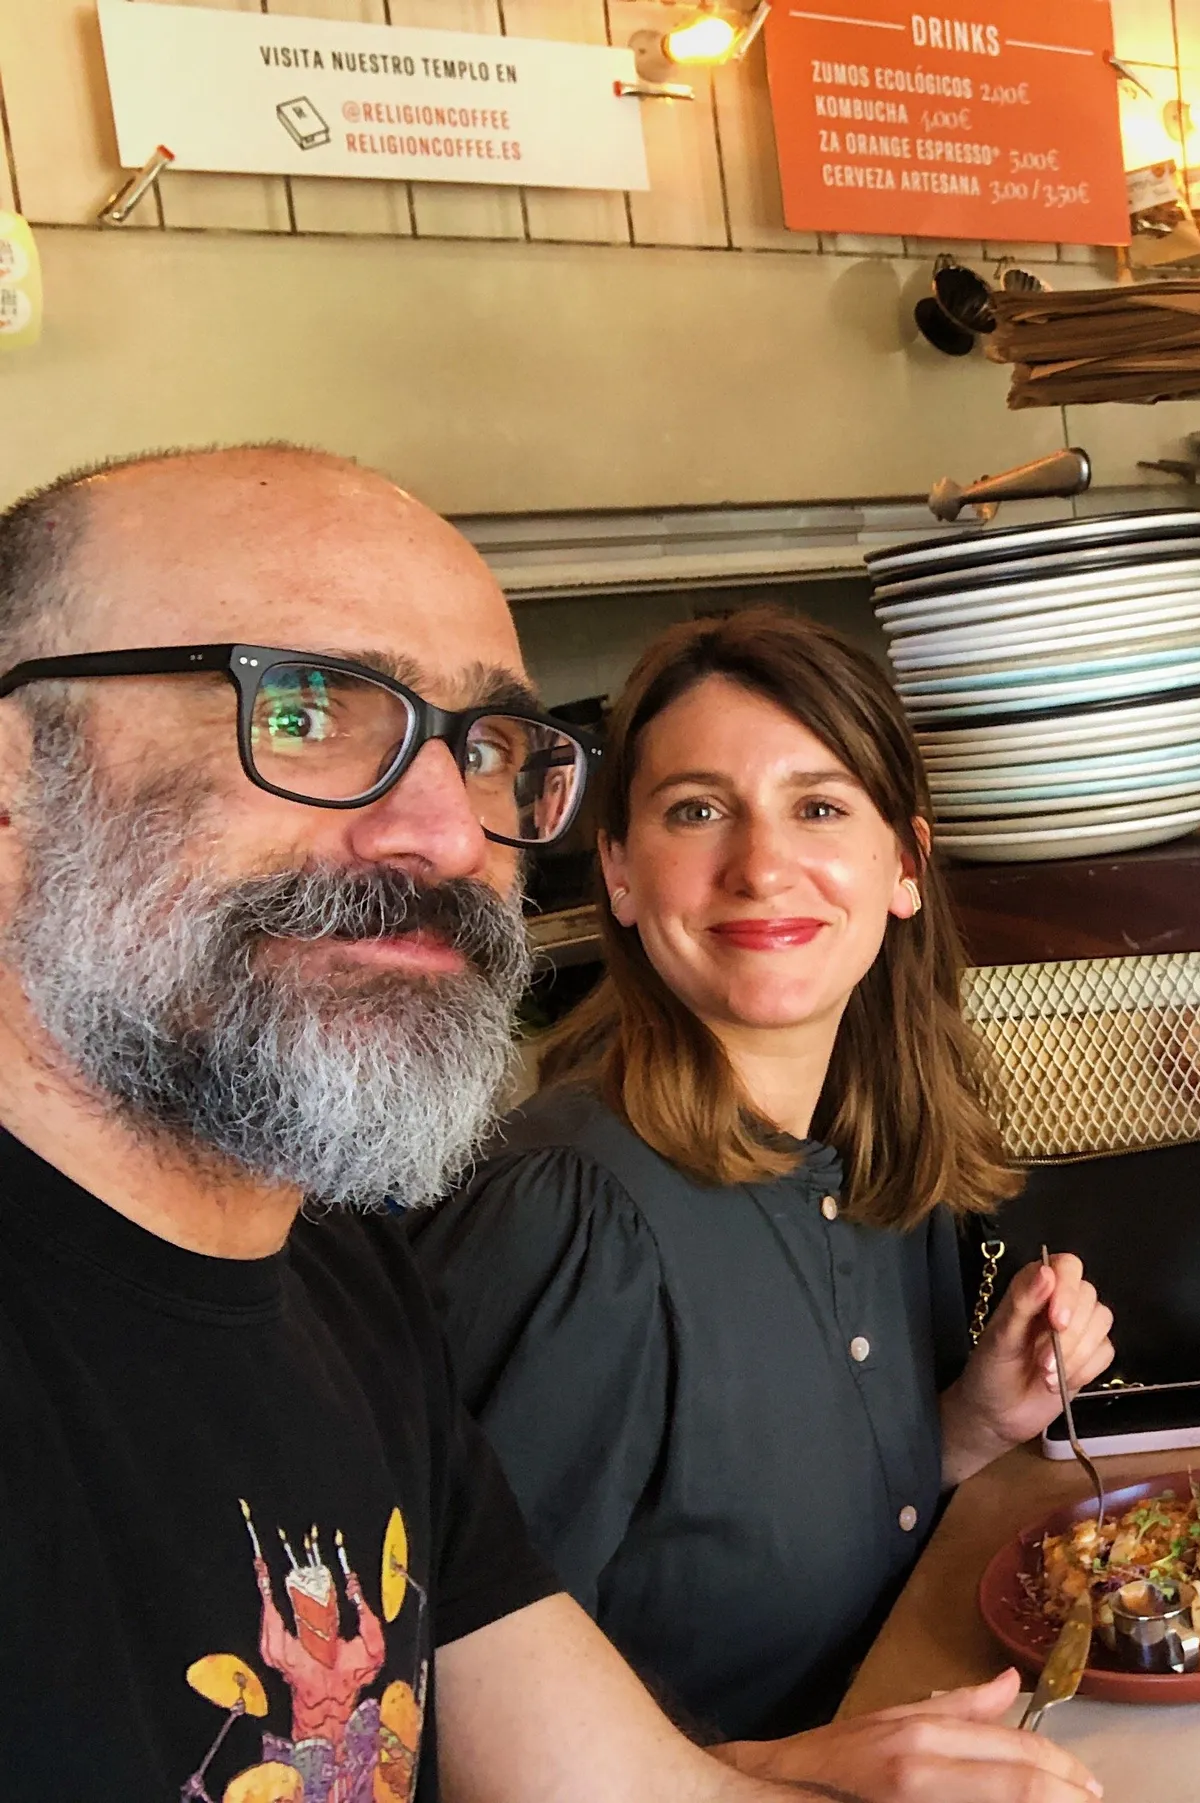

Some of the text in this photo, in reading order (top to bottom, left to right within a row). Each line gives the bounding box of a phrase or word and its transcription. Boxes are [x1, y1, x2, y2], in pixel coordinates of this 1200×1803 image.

[911, 13, 1001, 57] DRINKS
[259, 45, 518, 84] VISITA NUESTRO TEMPLO EN
[811, 59, 870, 88] ZUMOS
[874, 64, 973, 99] ECOLÓGICOS
[342, 100, 511, 130] @RELIGIONCOFFEE
[815, 95, 909, 124] KOMBUCHA
[345, 132, 522, 160] RELIGIONCOFFEE.ES
[818, 130, 841, 153] ZA
[845, 132, 912, 159] ORANGE
[822, 163, 897, 190] CERVEZA
[900, 170, 981, 196] ARTESANA
